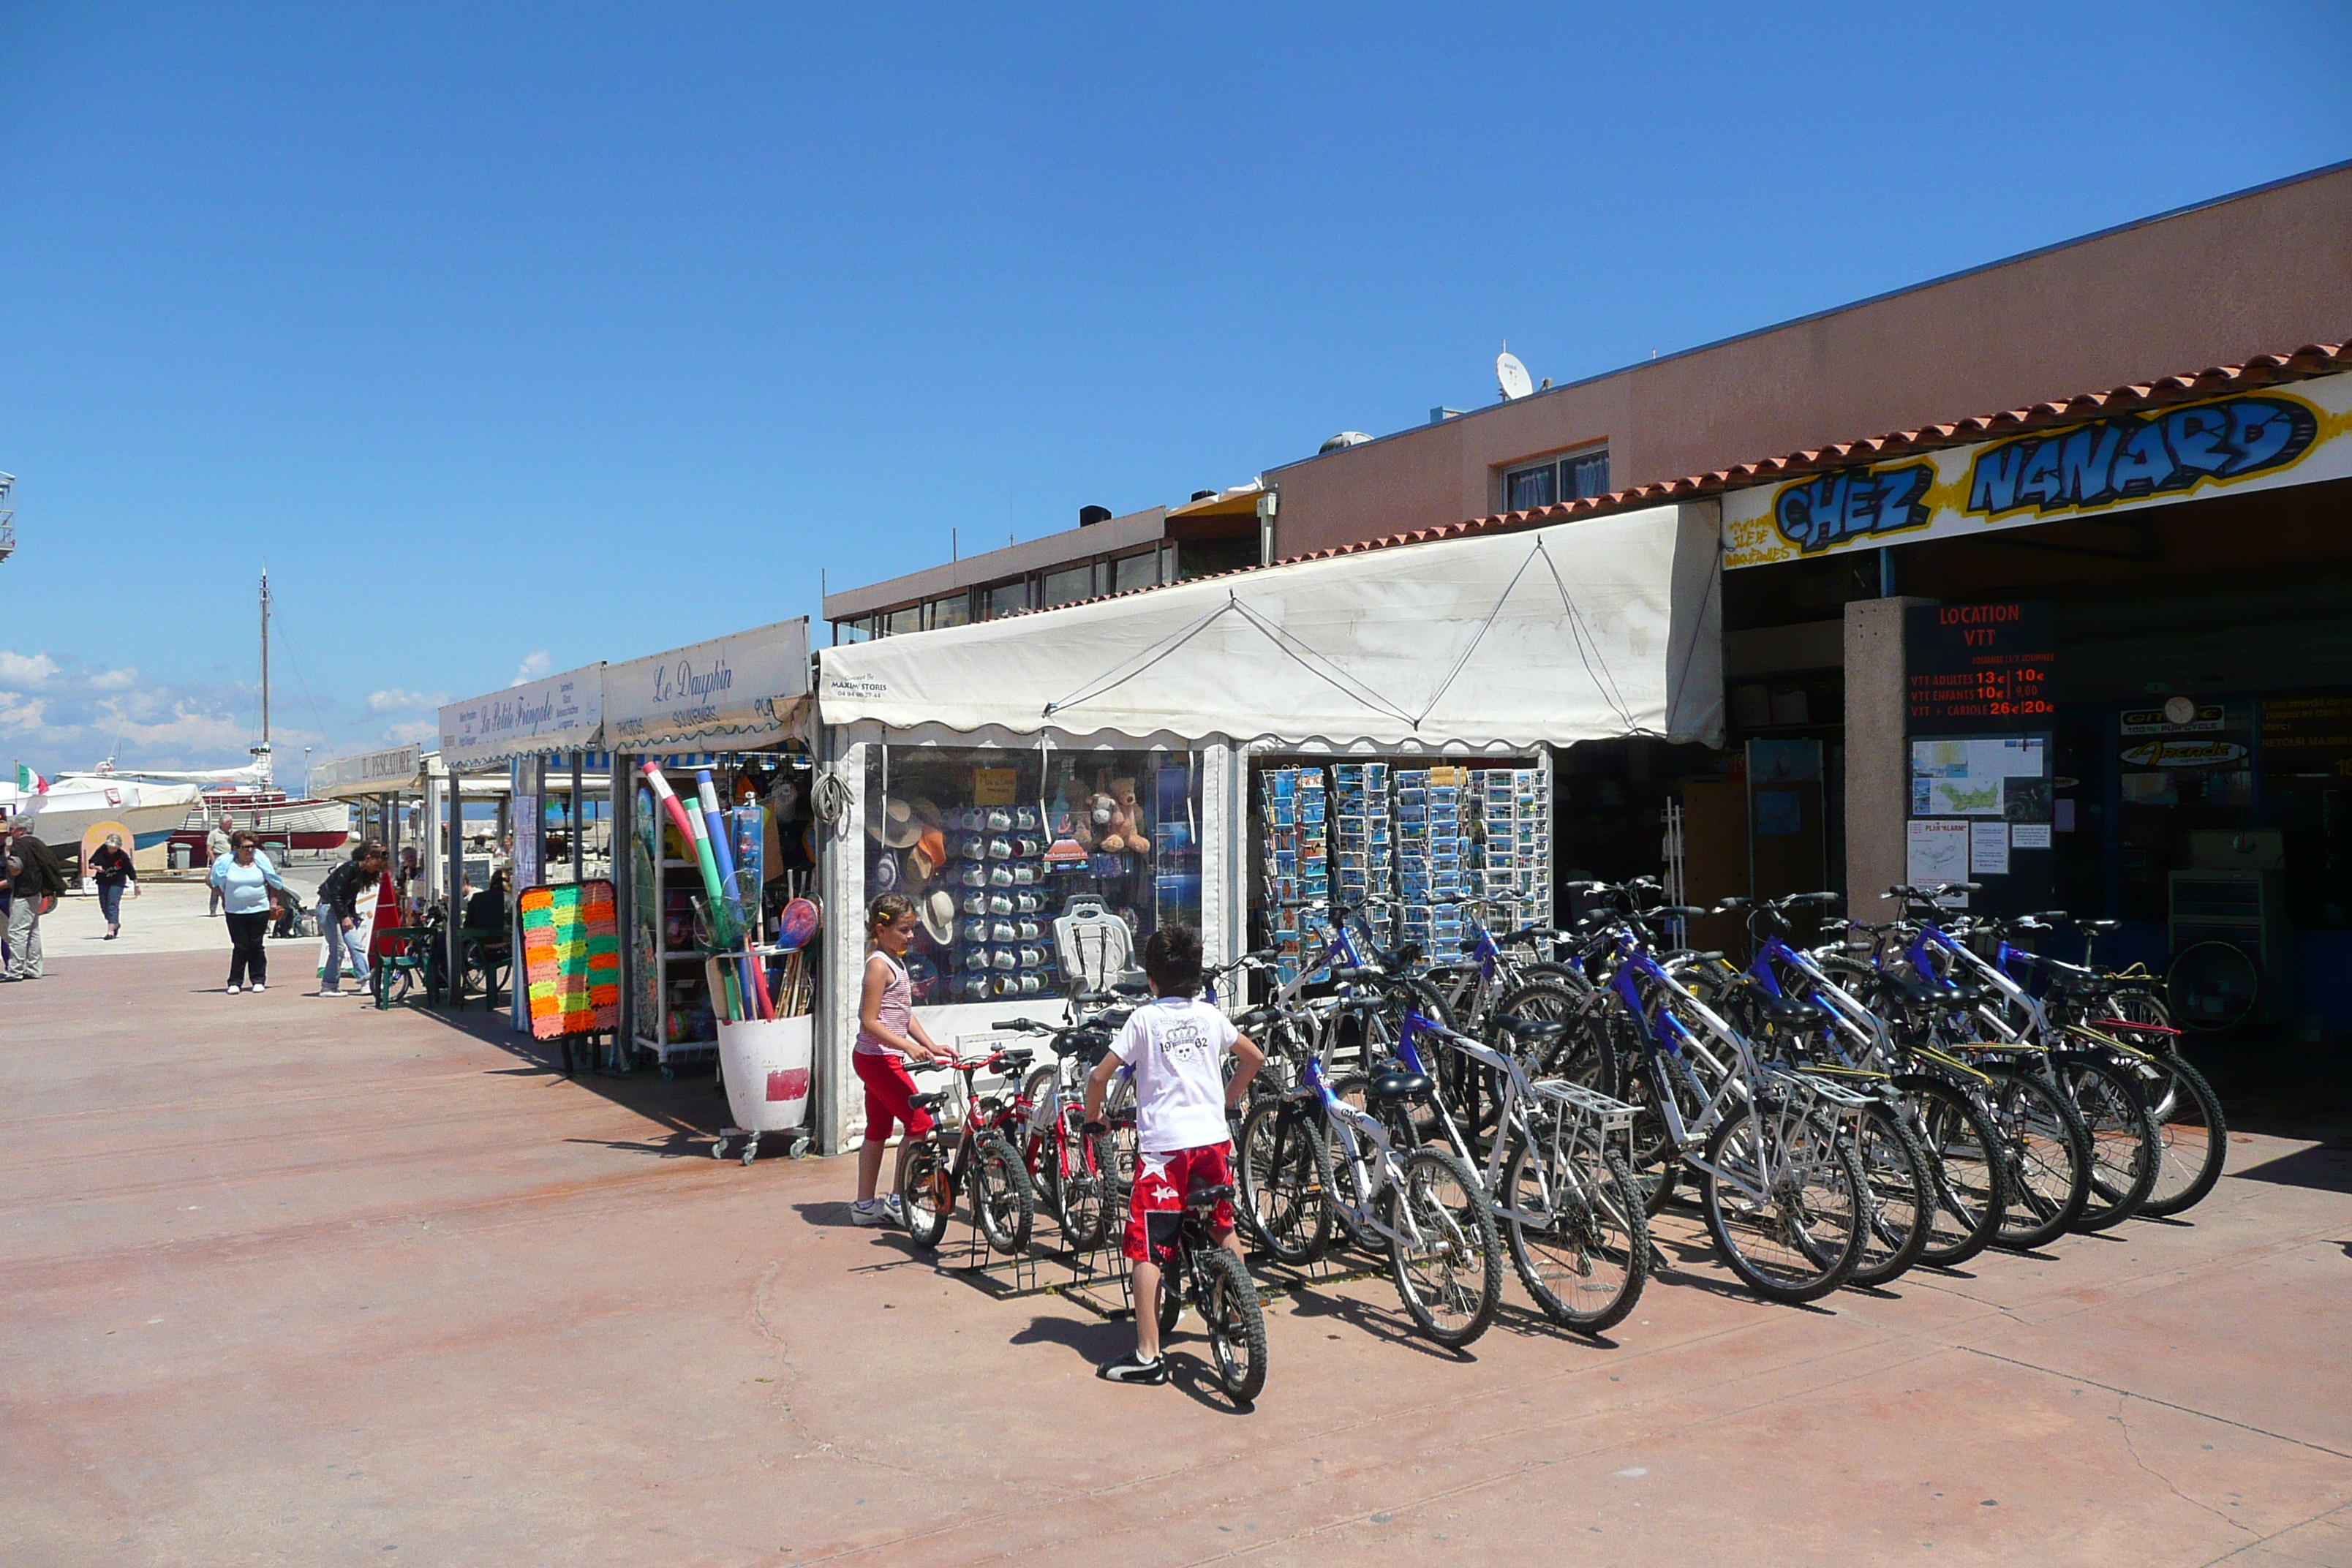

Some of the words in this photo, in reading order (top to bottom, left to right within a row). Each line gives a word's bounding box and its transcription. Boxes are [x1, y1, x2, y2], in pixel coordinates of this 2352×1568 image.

[1778, 467, 1922, 550] CHEZ
[1969, 402, 2295, 513] NANARD
[1940, 604, 2020, 625] LOCATION
[1964, 628, 1995, 647] VTT
[653, 666, 672, 704] Le
[677, 660, 733, 704] Dauphin
[861, 682, 887, 691] STORES
[1911, 676, 1930, 687] VTT
[1932, 674, 1974, 686] ADULTES
[1911, 691, 1930, 702] VTT
[1933, 689, 1975, 701] ENFANTS
[2016, 685, 2038, 698] 9,00
[672, 705, 720, 728] SOUVENIRS
[1911, 706, 1930, 717] VTT
[1948, 704, 1988, 716] CARIOLE
[616, 717, 645, 737] PHOTOS
[2185, 723, 2217, 731] CYCLE
[2262, 722, 2291, 731] Merci
[2262, 736, 2305, 747] RETOUR
[361, 758, 369, 779] IL
[372, 750, 412, 777] PESCATORE
[1159, 1042, 1172, 1053] 19
[1194, 1037, 1208, 1049] 62
